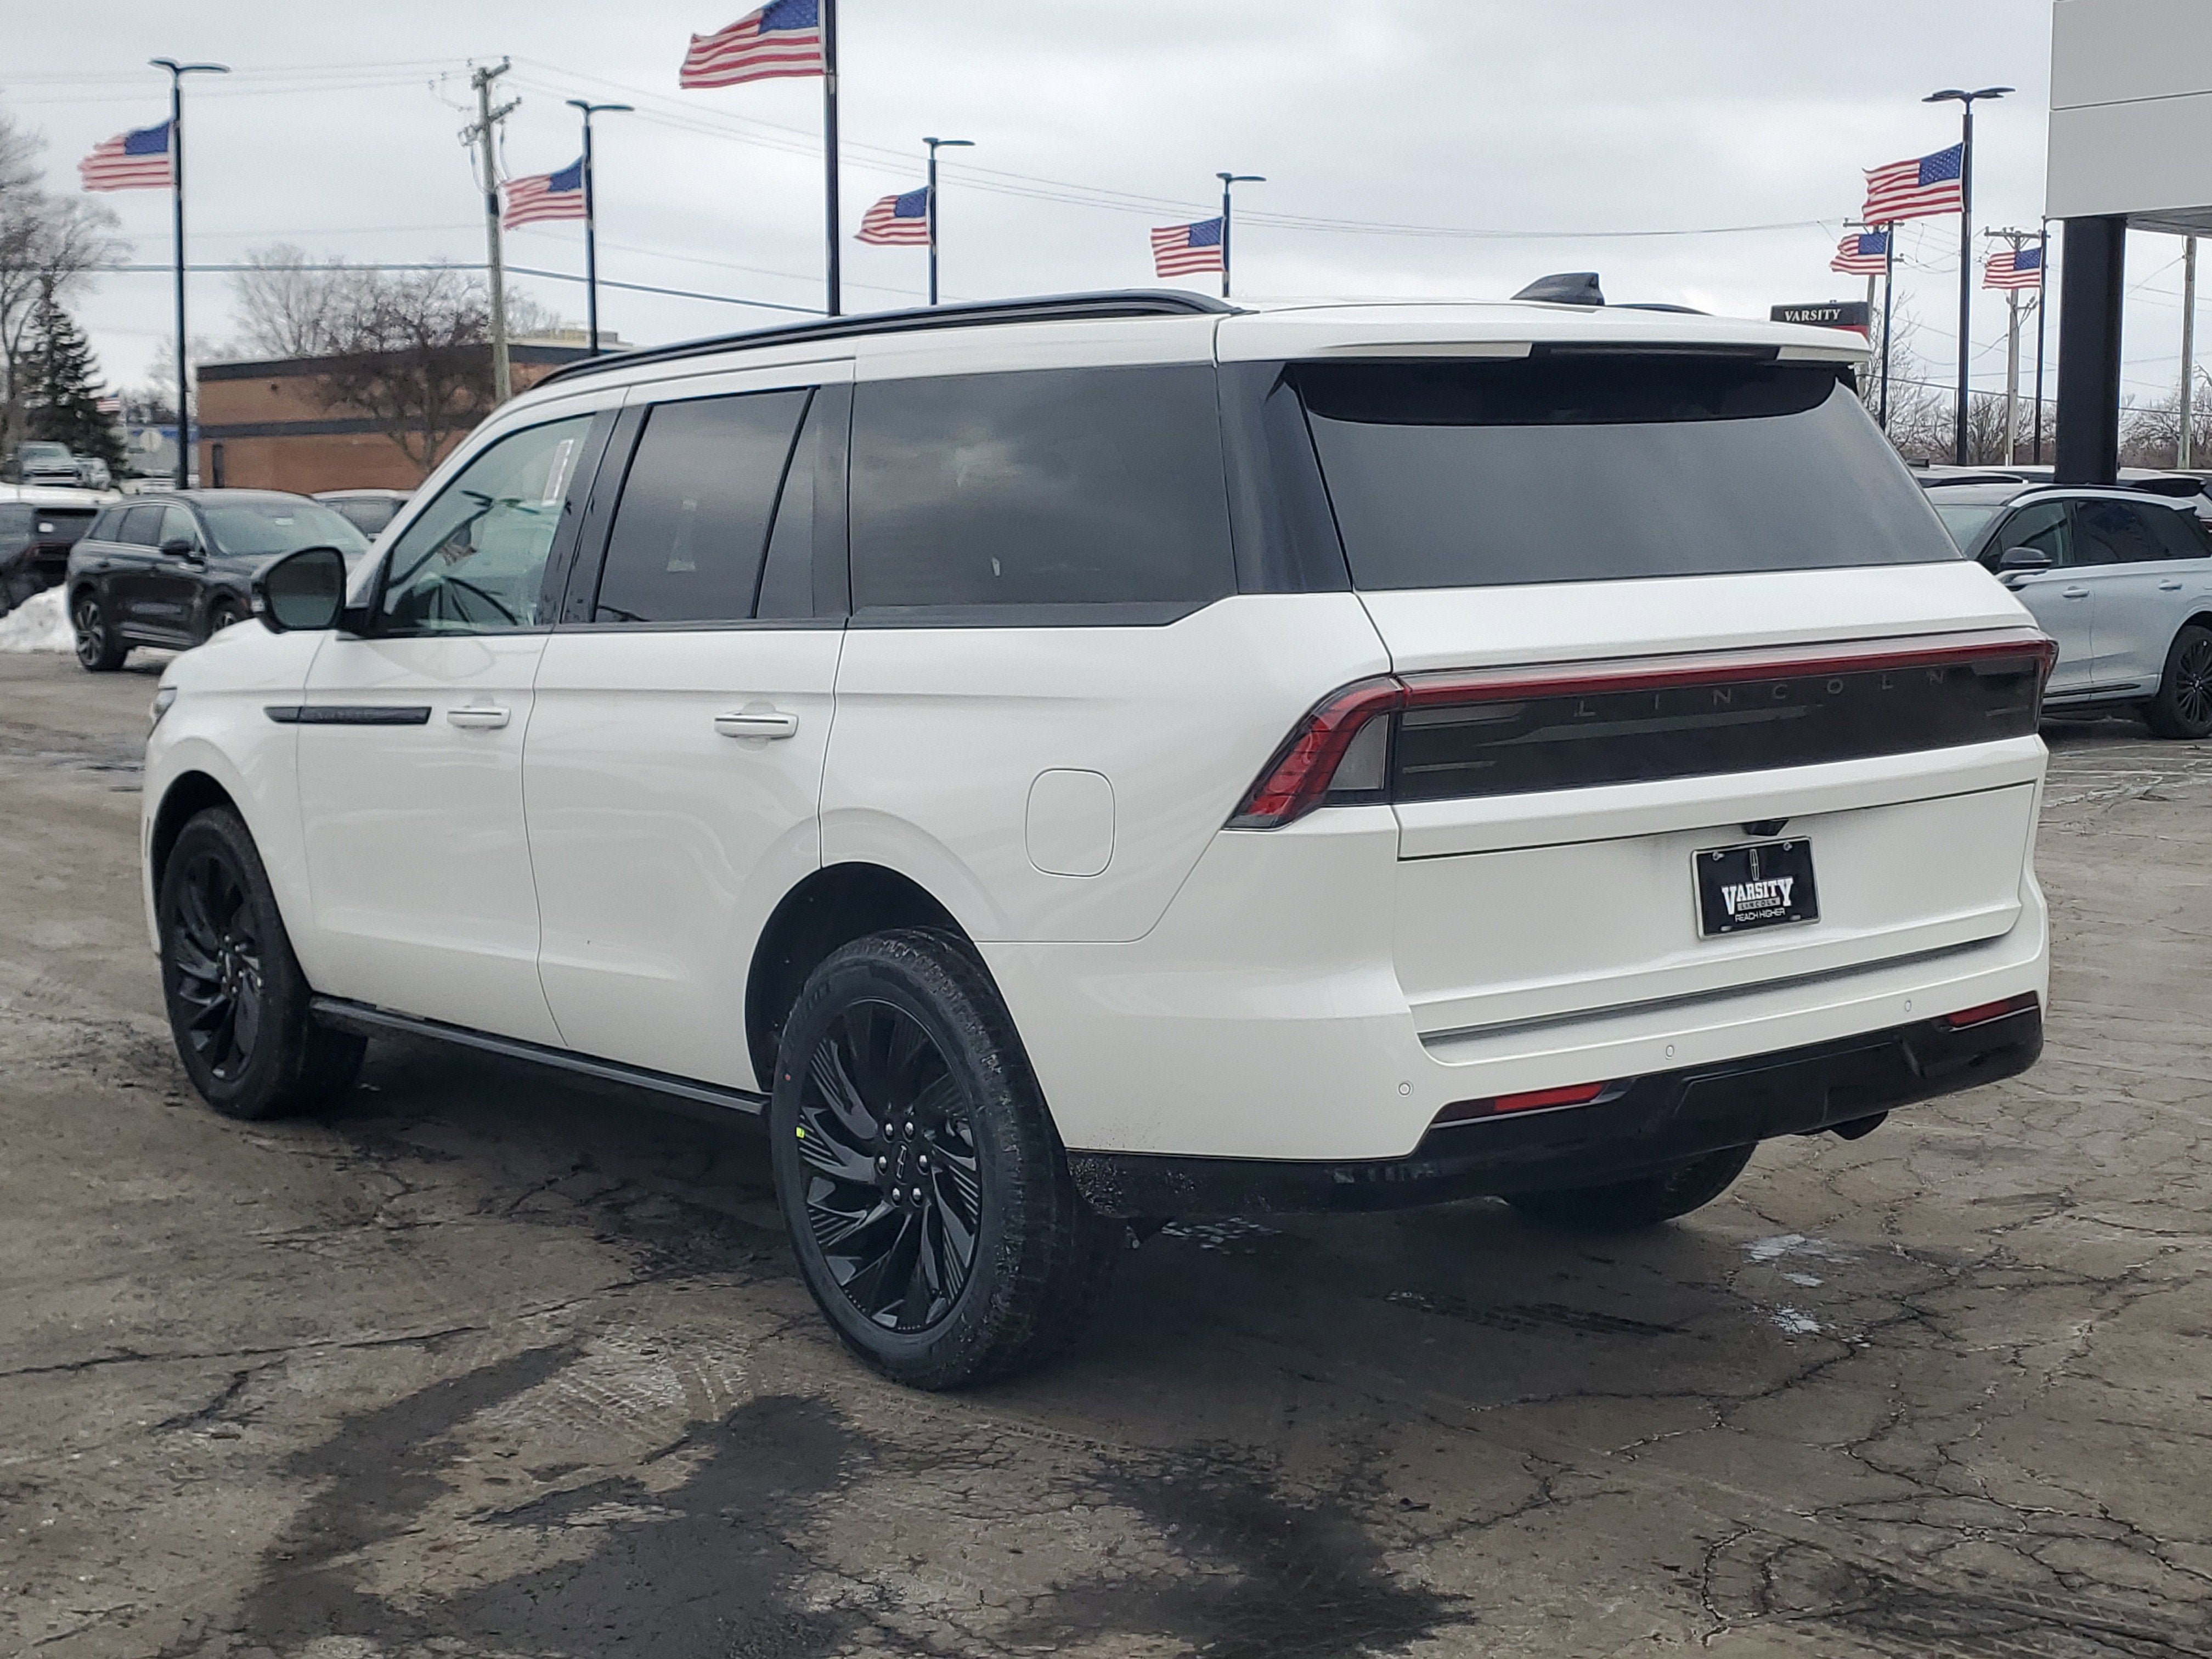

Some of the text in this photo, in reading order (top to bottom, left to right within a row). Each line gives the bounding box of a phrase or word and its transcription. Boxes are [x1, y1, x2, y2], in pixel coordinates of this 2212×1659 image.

[1785, 308, 1841, 321] VARSITY
[1574, 669, 1945, 717] LINCOLN
[1721, 877, 1793, 915] VARSITY
[1735, 908, 1785, 922] REACH HIGHER
